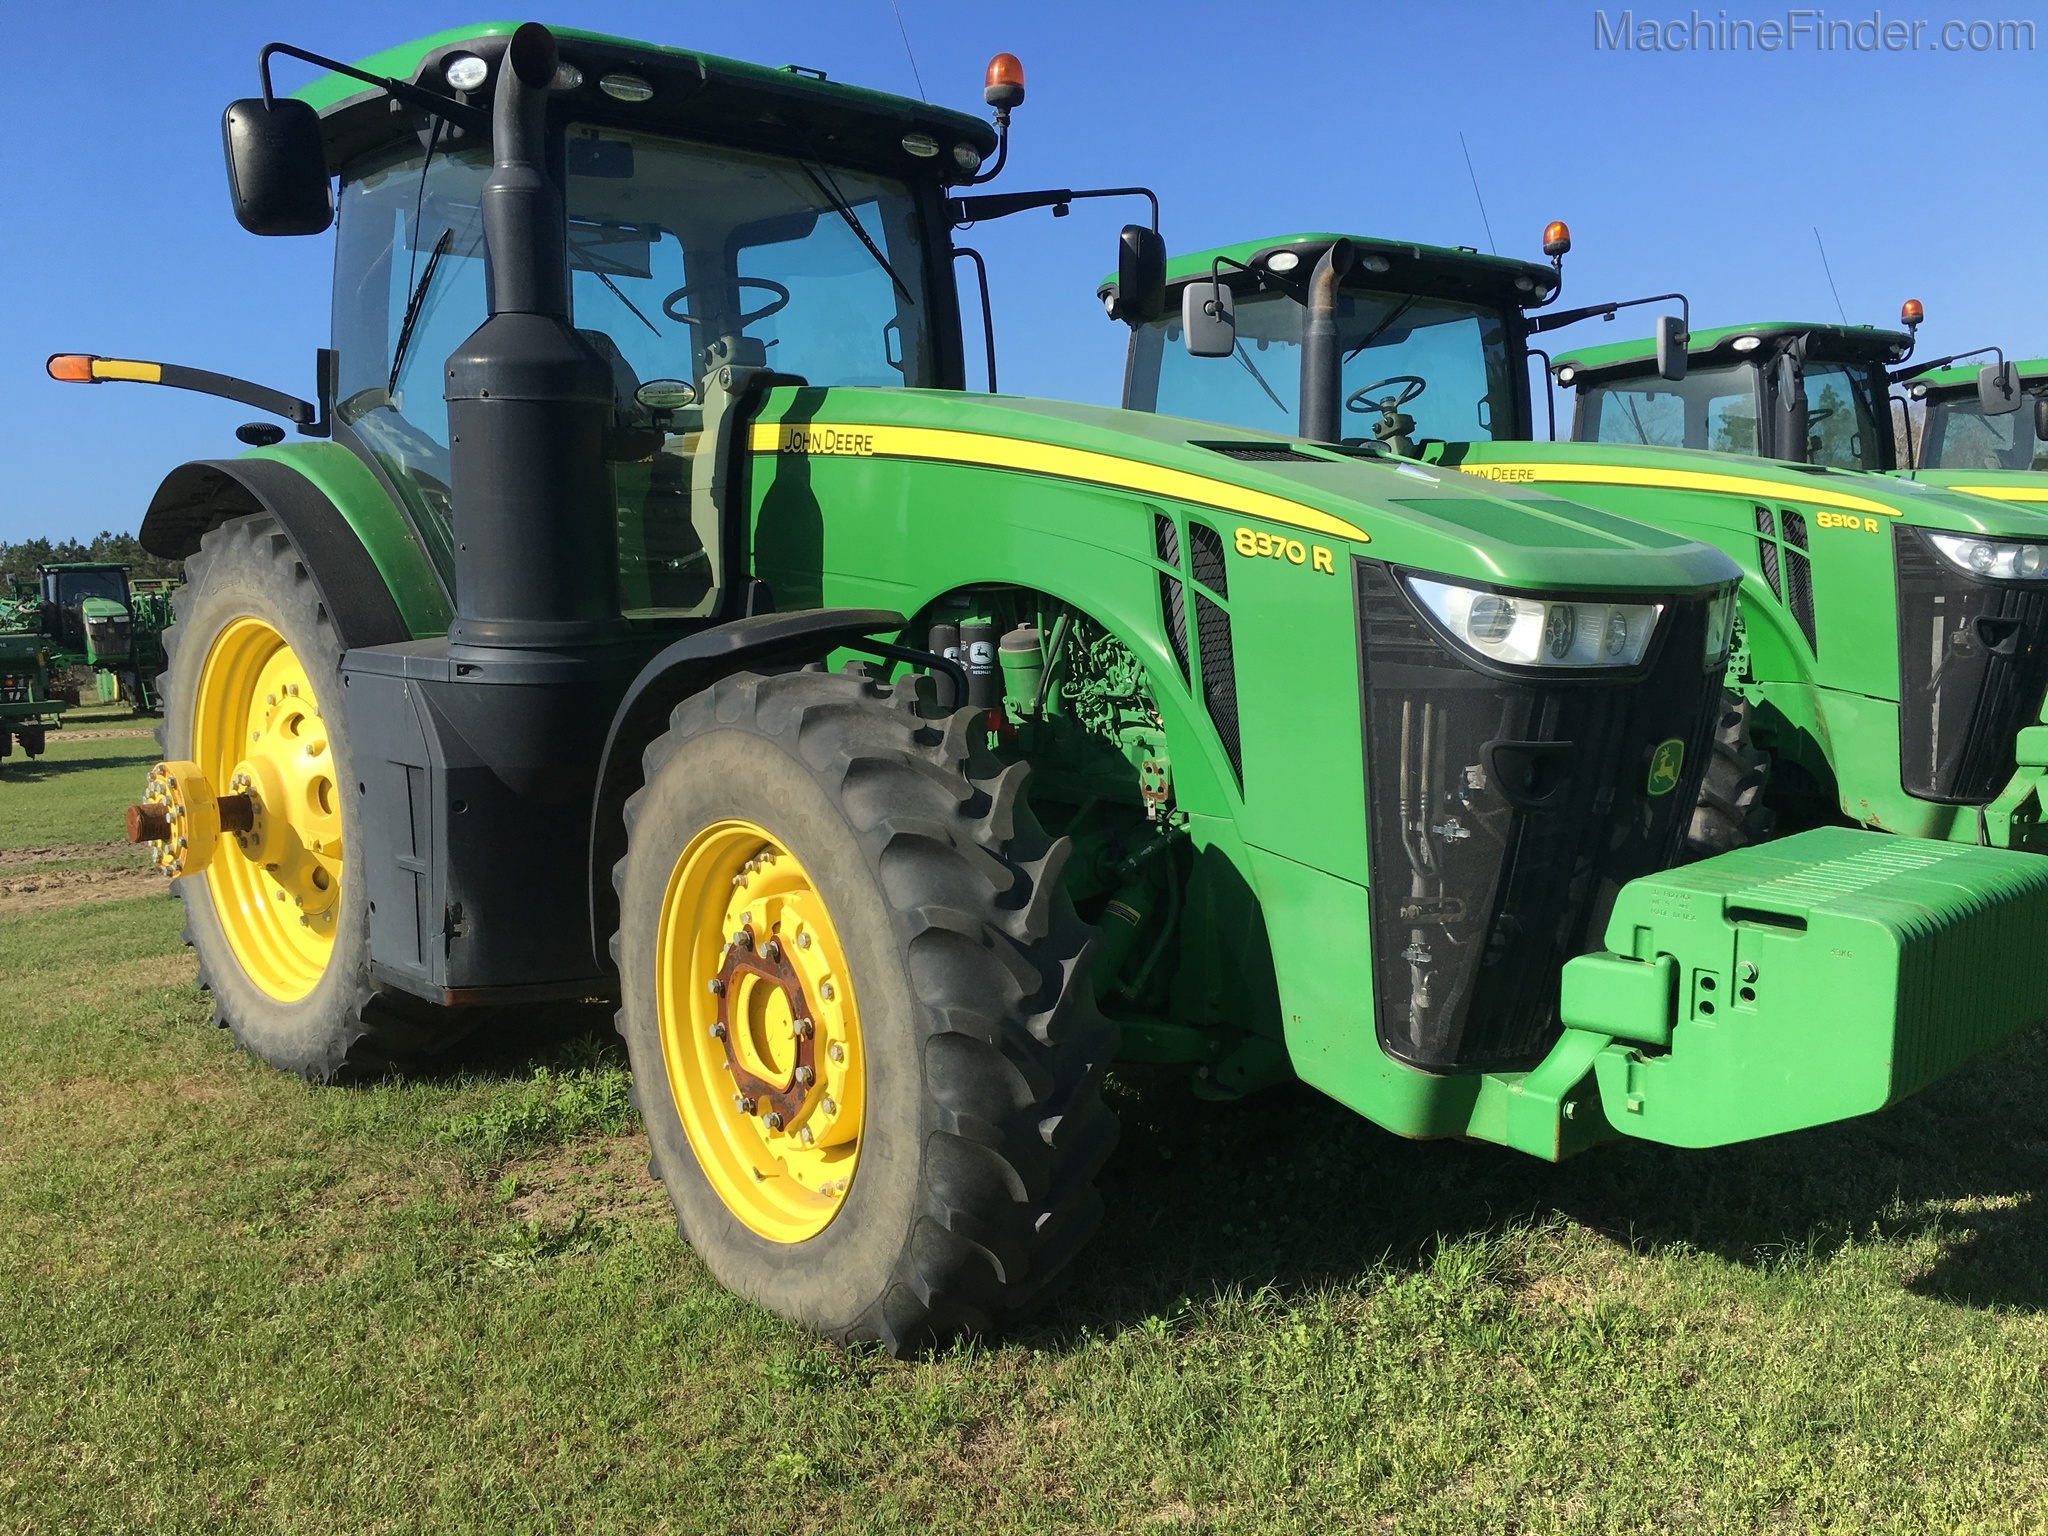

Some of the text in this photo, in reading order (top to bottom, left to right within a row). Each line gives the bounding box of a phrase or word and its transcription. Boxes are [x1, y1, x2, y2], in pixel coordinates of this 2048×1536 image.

[785, 428, 874, 452] JOHN DEERE
[1491, 467, 1535, 480] DEERE
[1816, 511, 1879, 534] 8310 R
[1234, 527, 1335, 576] 8370 R
